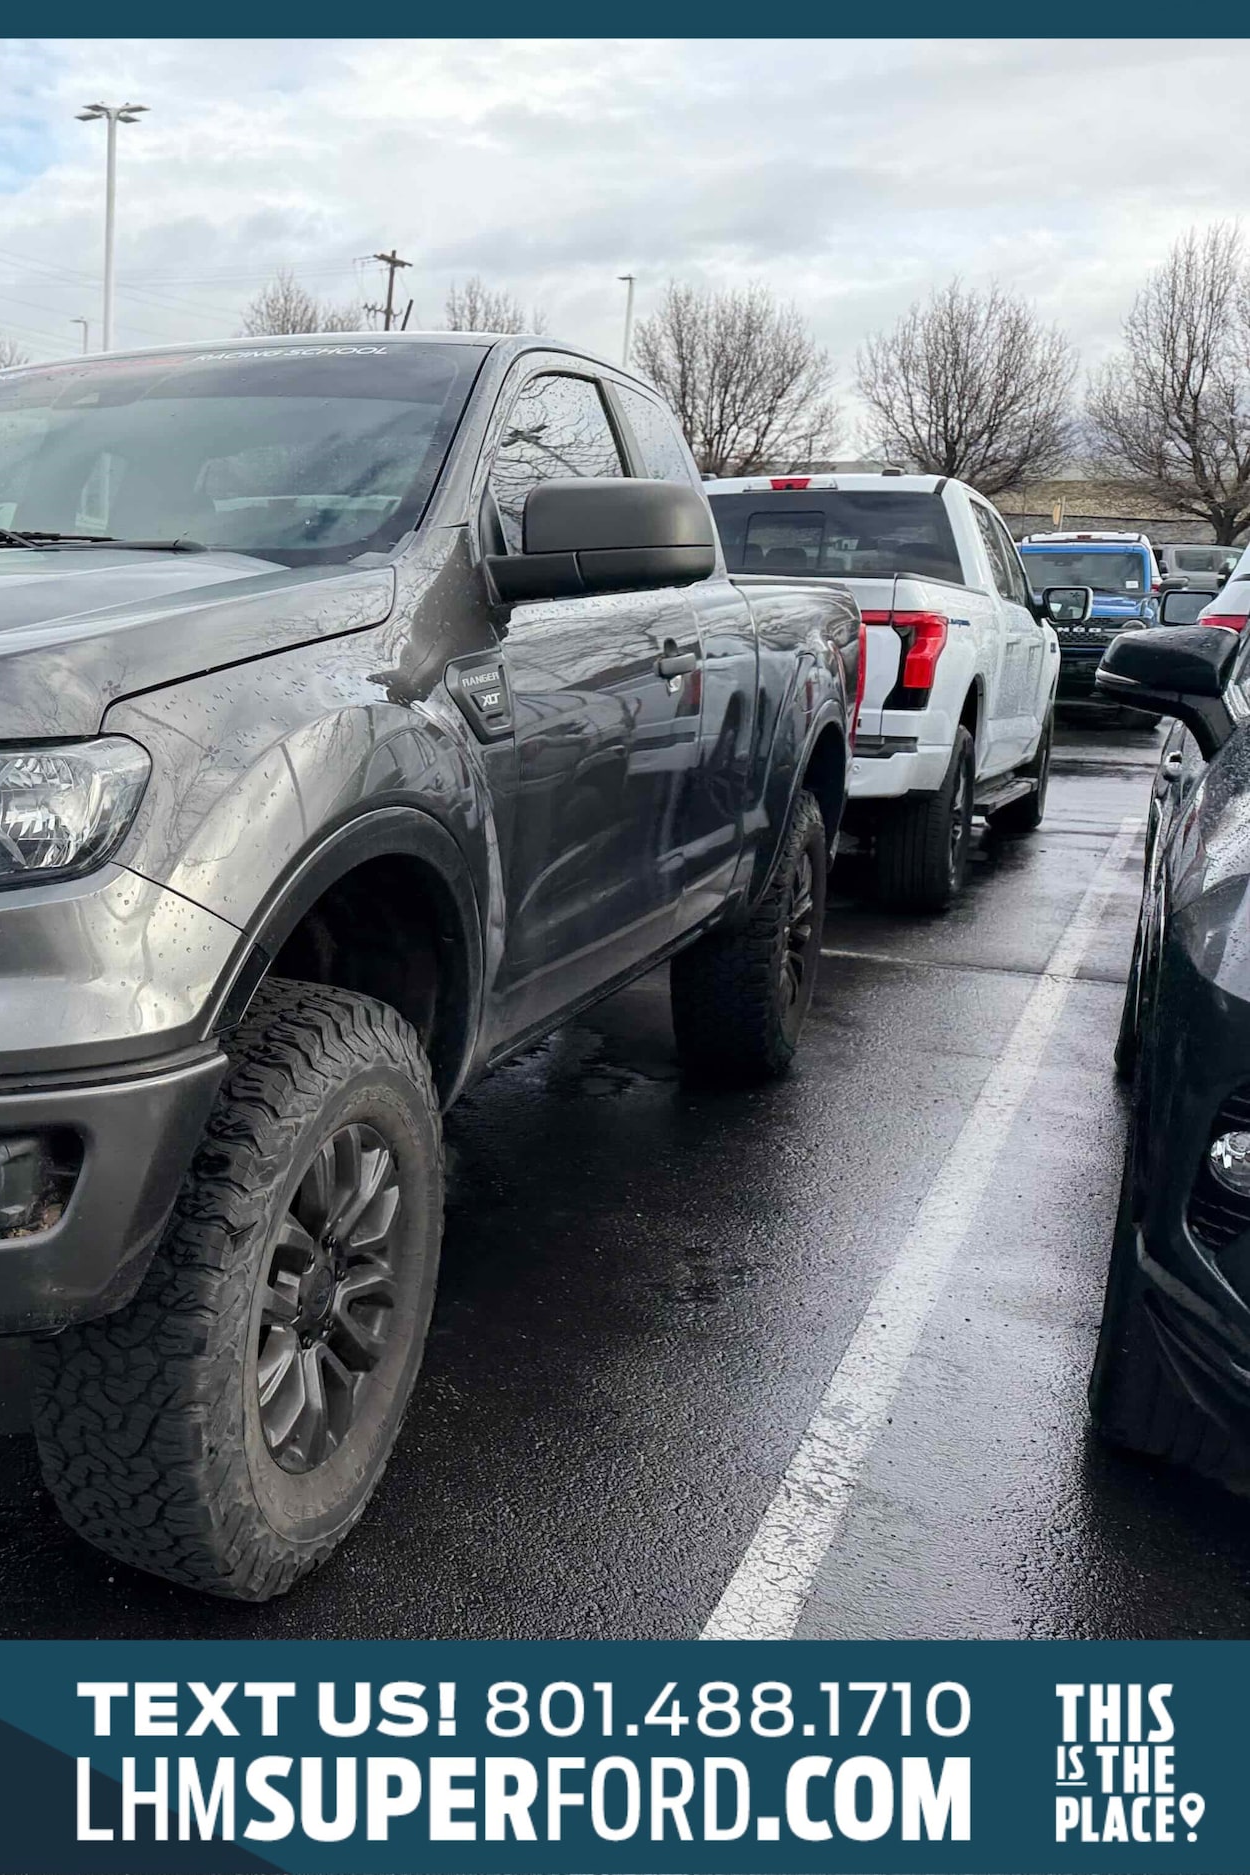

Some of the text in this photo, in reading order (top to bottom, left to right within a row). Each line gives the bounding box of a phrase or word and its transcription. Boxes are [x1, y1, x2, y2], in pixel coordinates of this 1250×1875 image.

[192, 346, 389, 362] RACING SCHOOL
[462, 671, 500, 688] RANGER
[481, 692, 501, 707] XLT
